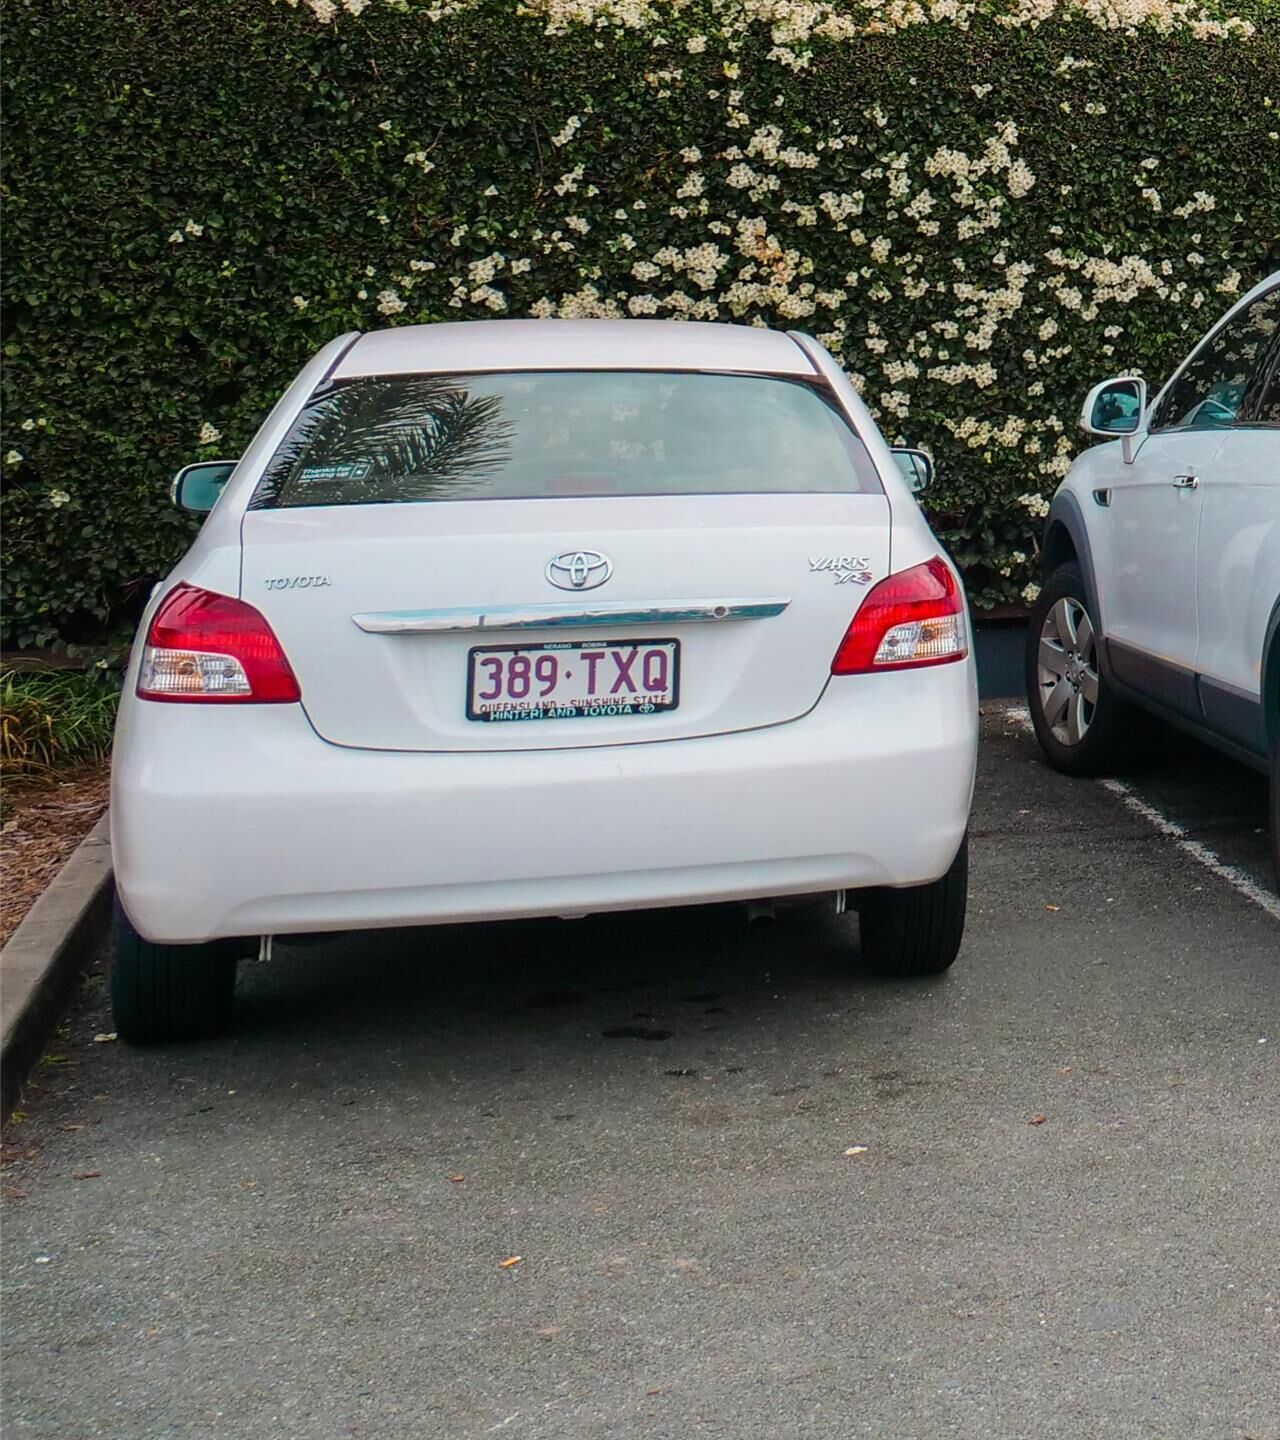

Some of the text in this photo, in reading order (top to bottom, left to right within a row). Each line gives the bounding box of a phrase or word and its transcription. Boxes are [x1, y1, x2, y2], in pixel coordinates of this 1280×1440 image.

[265, 576, 331, 591] TOYOTA
[633, 695, 667, 704] STATE
[584, 704, 633, 716] TOYOTA
